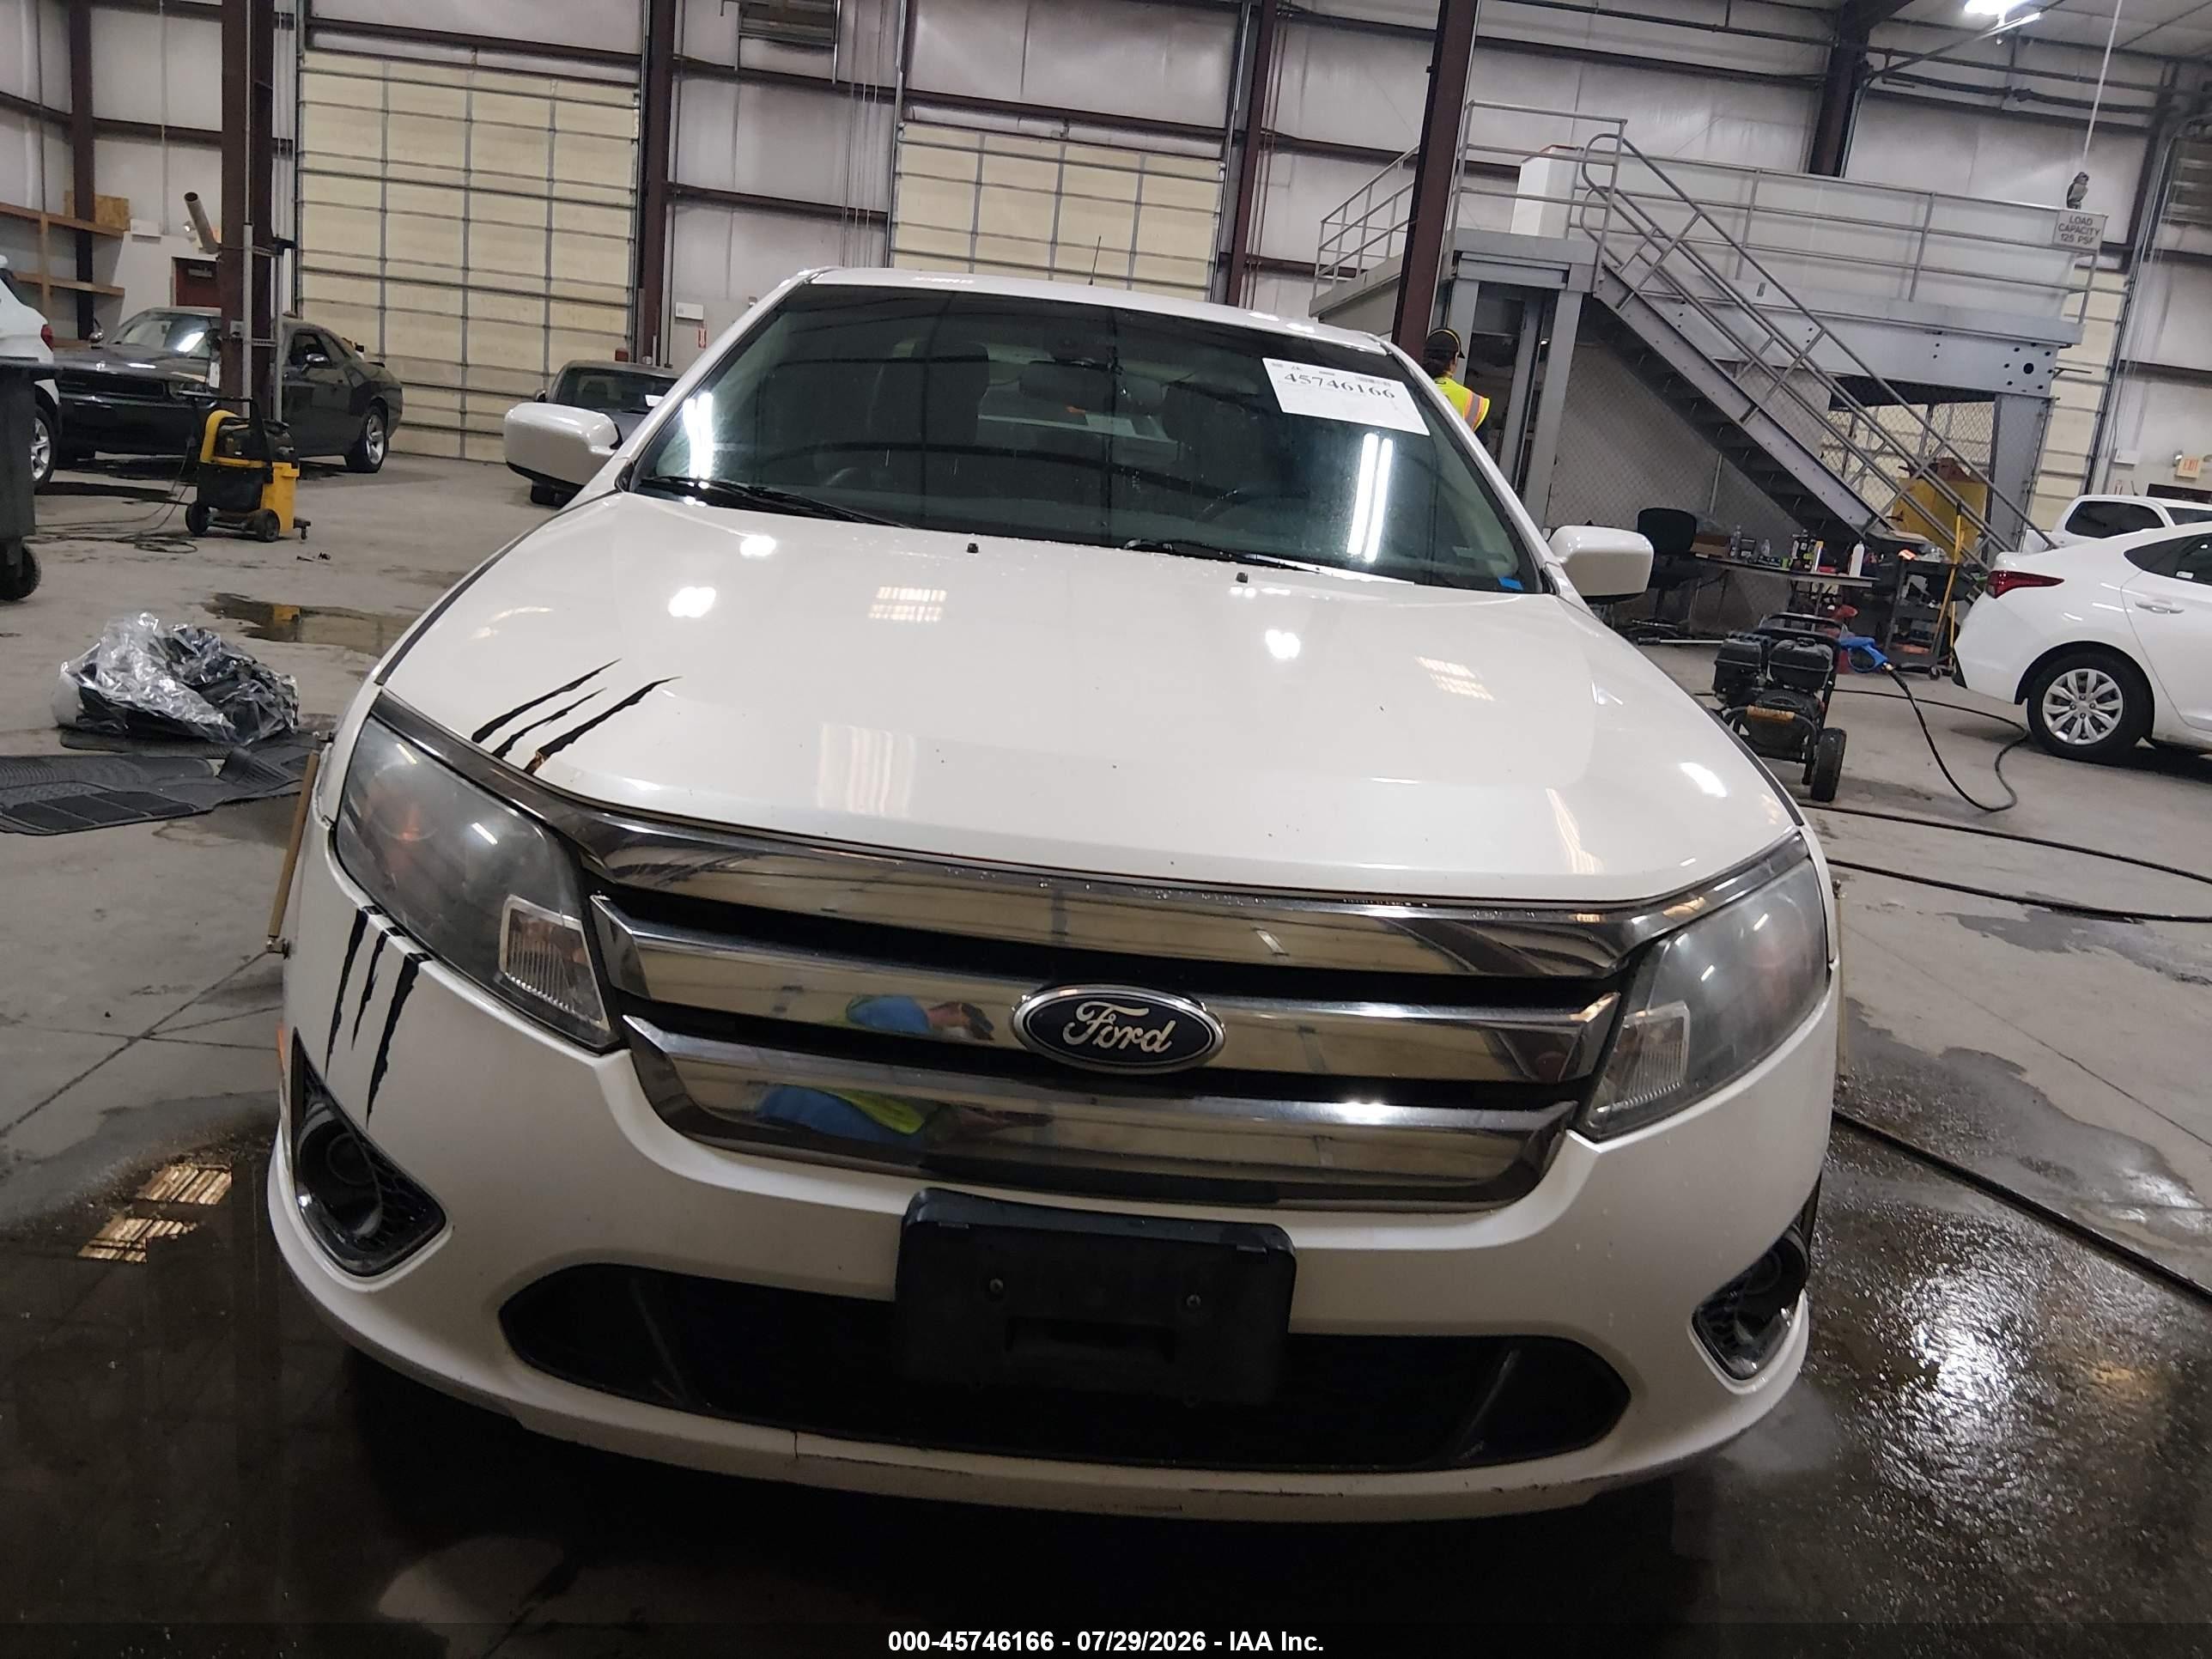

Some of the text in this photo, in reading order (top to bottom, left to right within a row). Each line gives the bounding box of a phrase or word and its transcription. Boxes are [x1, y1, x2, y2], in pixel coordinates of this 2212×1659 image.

[2069, 215, 2094, 226] LOAD
[2057, 223, 2101, 236] CAPACITY
[2060, 233, 2094, 245] 125 PSF
[1284, 373, 1395, 399] 45746166
[1062, 1000, 1177, 1054] Ford
